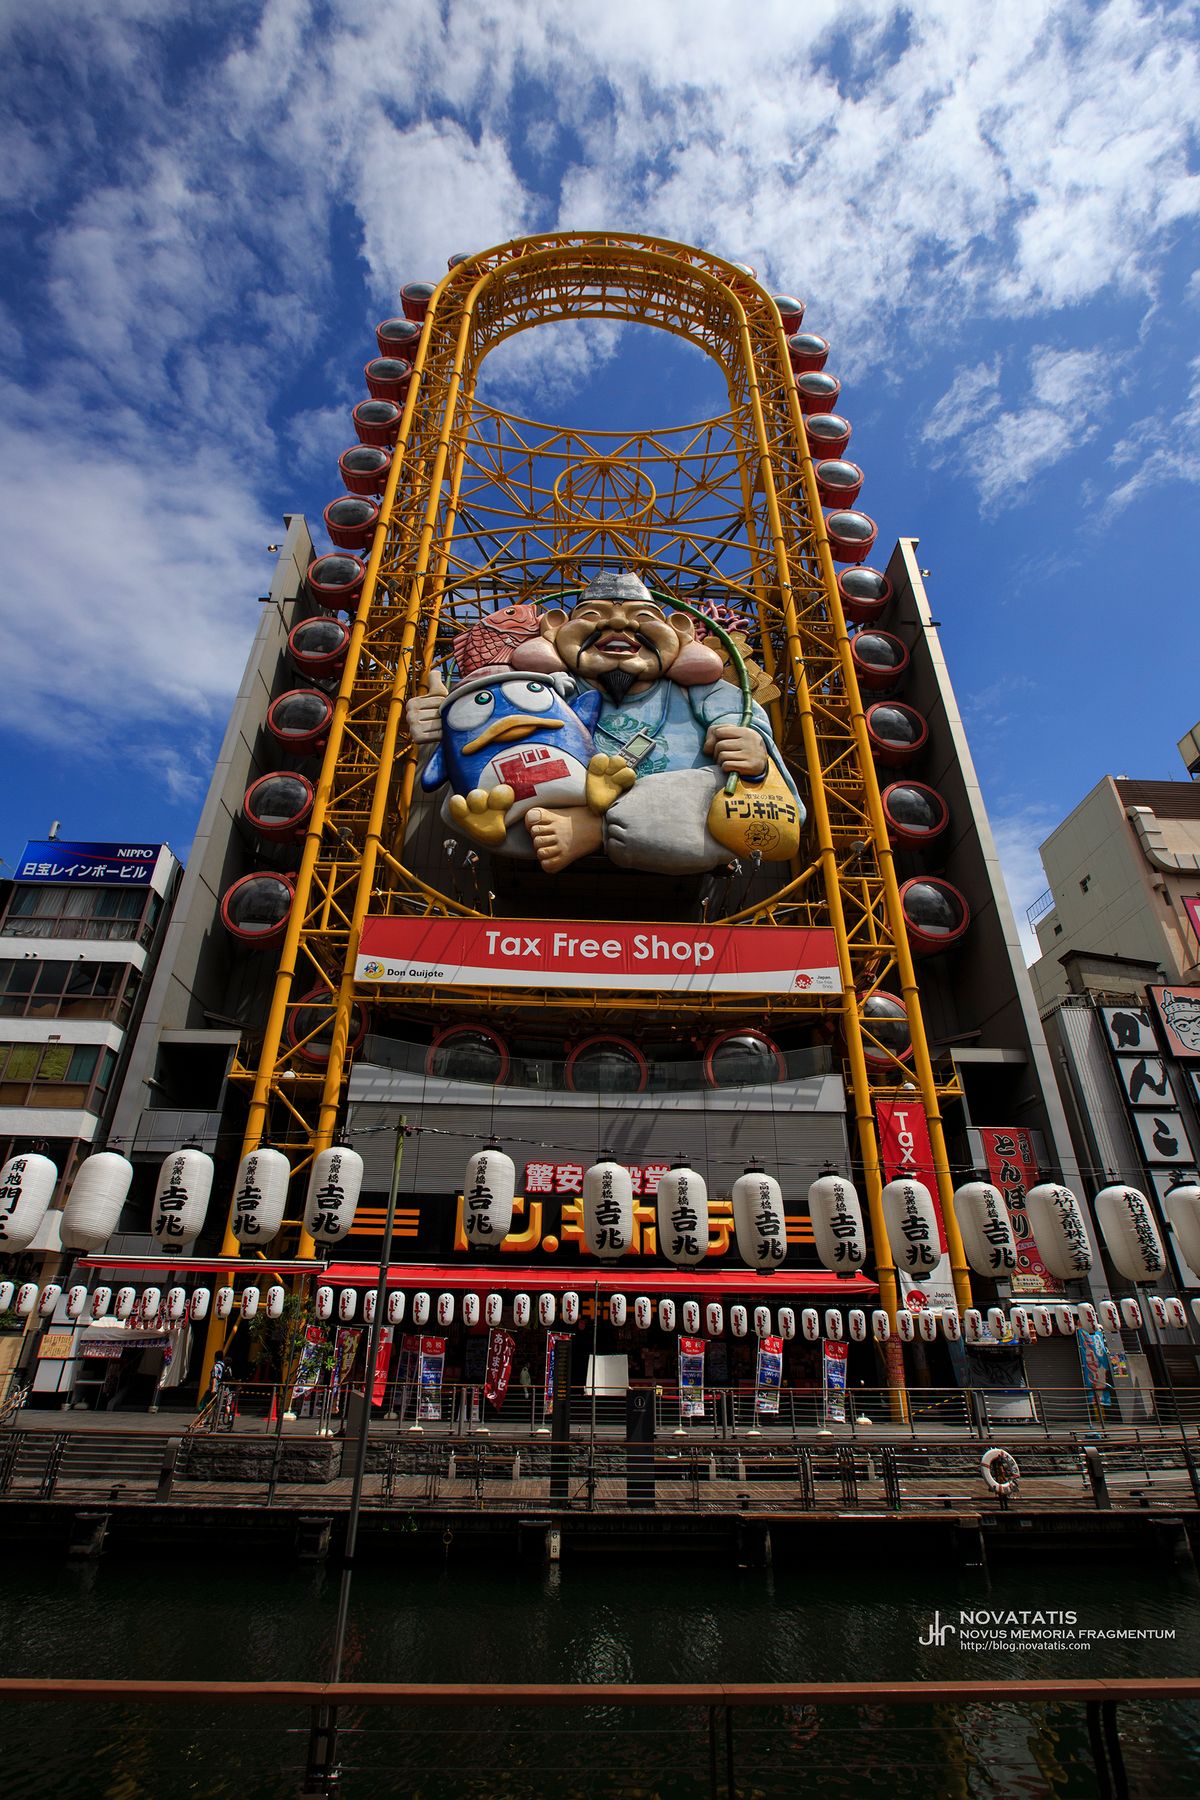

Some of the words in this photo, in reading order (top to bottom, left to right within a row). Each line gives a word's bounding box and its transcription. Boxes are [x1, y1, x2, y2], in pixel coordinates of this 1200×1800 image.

[22, 862, 148, 879] 日宝レインボービル
[117, 848, 154, 858] NIPPO
[485, 930, 541, 957] Tax
[552, 932, 622, 959] Free
[632, 934, 715, 967] Shop
[387, 968, 406, 977] Don
[408, 969, 444, 979] Quijote
[893, 1111, 917, 1164] Tax
[1050, 1189, 1092, 1272] 松竹芸能株式会社
[1123, 1191, 1162, 1273] 松竹芸能株式会社
